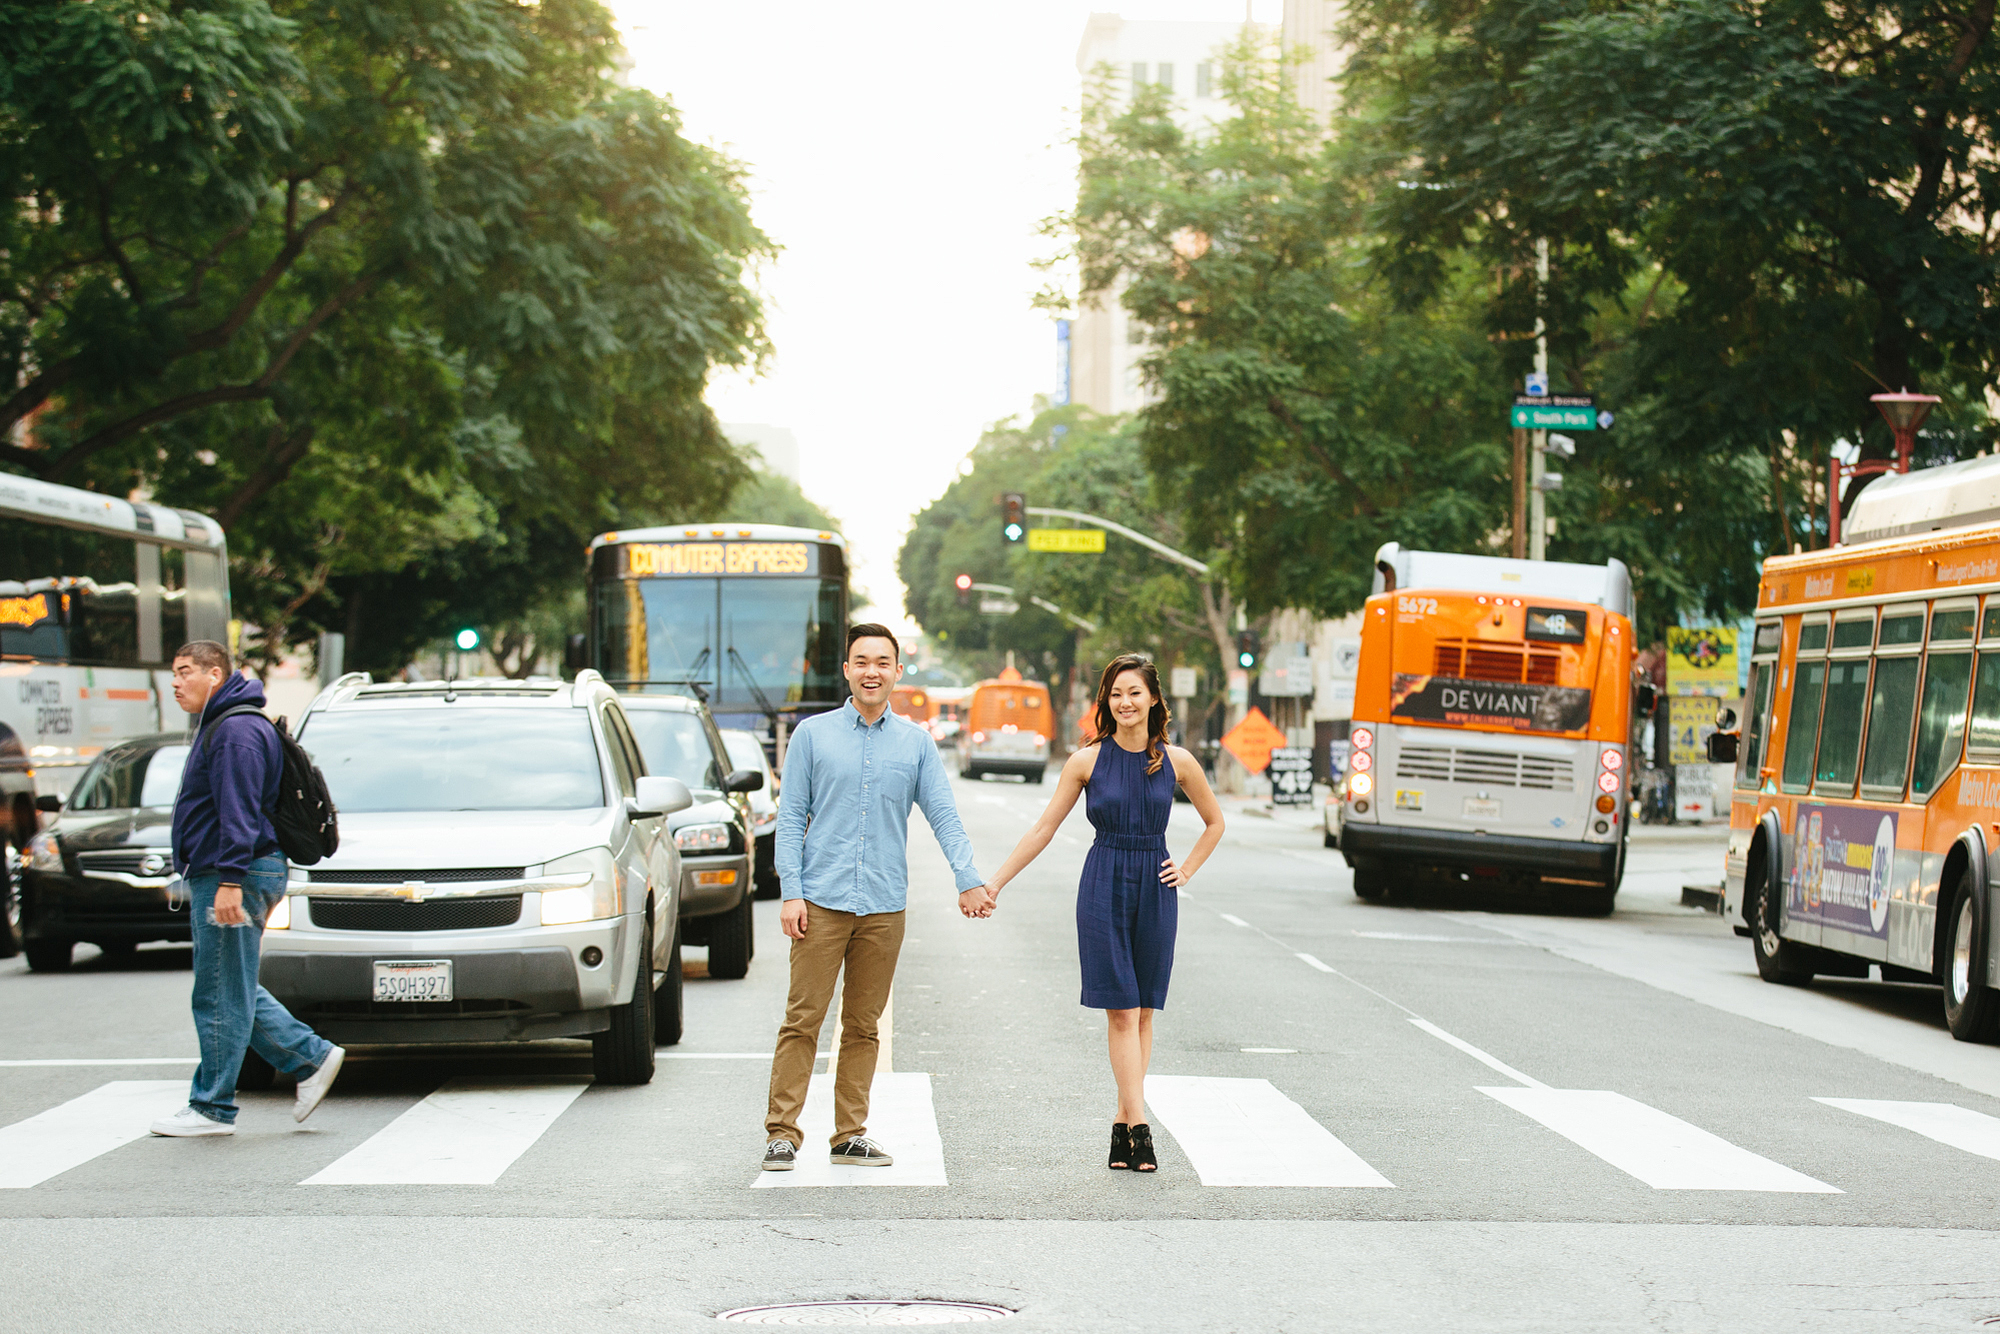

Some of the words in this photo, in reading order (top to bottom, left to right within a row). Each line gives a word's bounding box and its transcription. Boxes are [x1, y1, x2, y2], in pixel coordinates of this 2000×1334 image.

[1533, 411, 1563, 424] South
[1564, 411, 1588, 425] Park
[629, 543, 725, 574] COMMUTER
[725, 543, 808, 573] EXPRESS
[1804, 575, 1820, 598] Metro
[1819, 572, 1835, 597] Local
[1398, 597, 1438, 615] 5672
[1544, 614, 1567, 636] 48
[1441, 688, 1541, 715] DEVIANT
[1672, 701, 1712, 709] FLAT
[37, 706, 73, 735] EXPRESS
[1673, 714, 1710, 722] RATE
[1681, 726, 1695, 748] 4
[1677, 766, 1711, 781] PUBLIC
[1677, 784, 1712, 797] PARKING
[1958, 772, 1984, 807] Metro
[1820, 868, 1843, 905] NOW
[1841, 871, 1870, 911] AVAILABLE
[379, 976, 447, 995] 5SQH397
